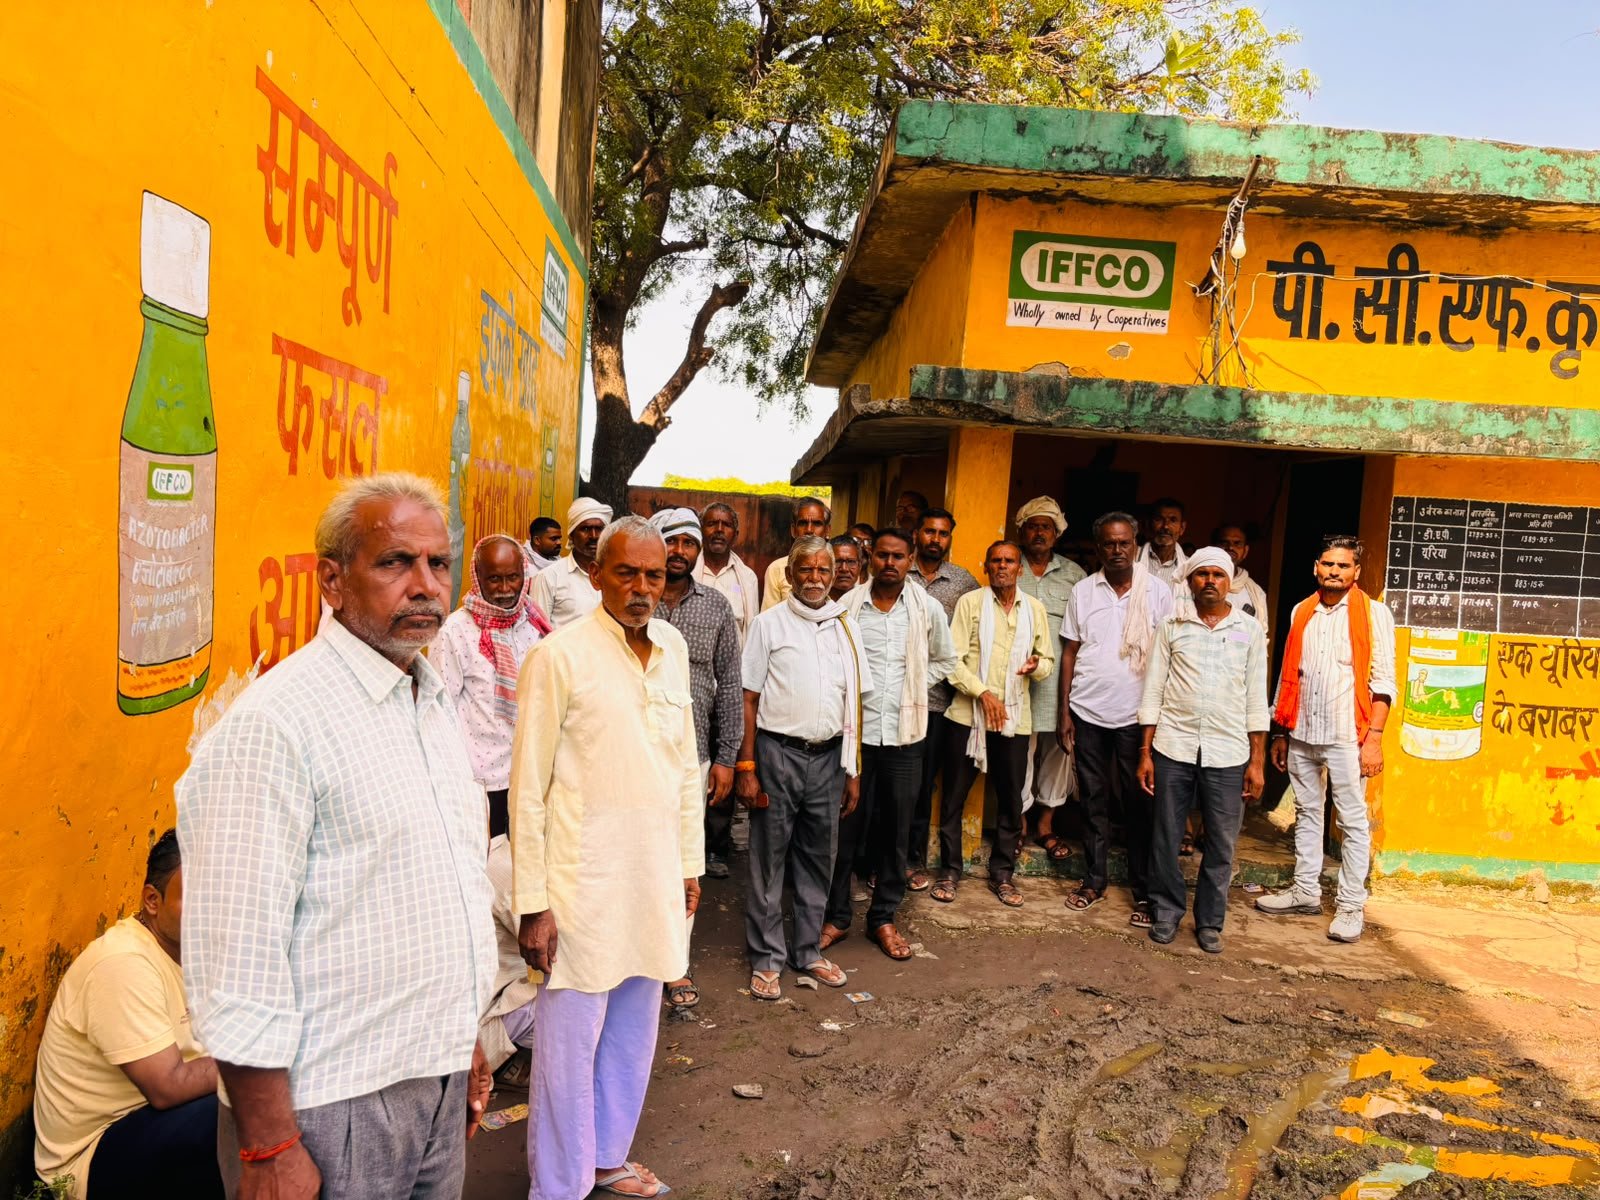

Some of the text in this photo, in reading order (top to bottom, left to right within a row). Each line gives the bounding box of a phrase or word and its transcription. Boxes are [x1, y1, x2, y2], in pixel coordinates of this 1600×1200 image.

[256, 66, 400, 325] सम्पूर्ण
[1037, 249, 1150, 292] IFFCO
[1013, 301, 1167, 331] Wholly owned by Cooperatives
[272, 332, 389, 480] फसल
[154, 471, 187, 492] IFFCO
[128, 513, 209, 550] AZOTOBACTER
[1397, 530, 1403, 538] 1
[1395, 547, 1401, 558] 2
[1421, 544, 1447, 561] यूरिया
[1393, 573, 1400, 584] 3
[1391, 599, 1399, 613] 4
[1497, 640, 1538, 679] एक
[1540, 638, 1600, 688] यूरिय
[1491, 689, 1516, 735] के
[1518, 702, 1599, 742] बराबर
